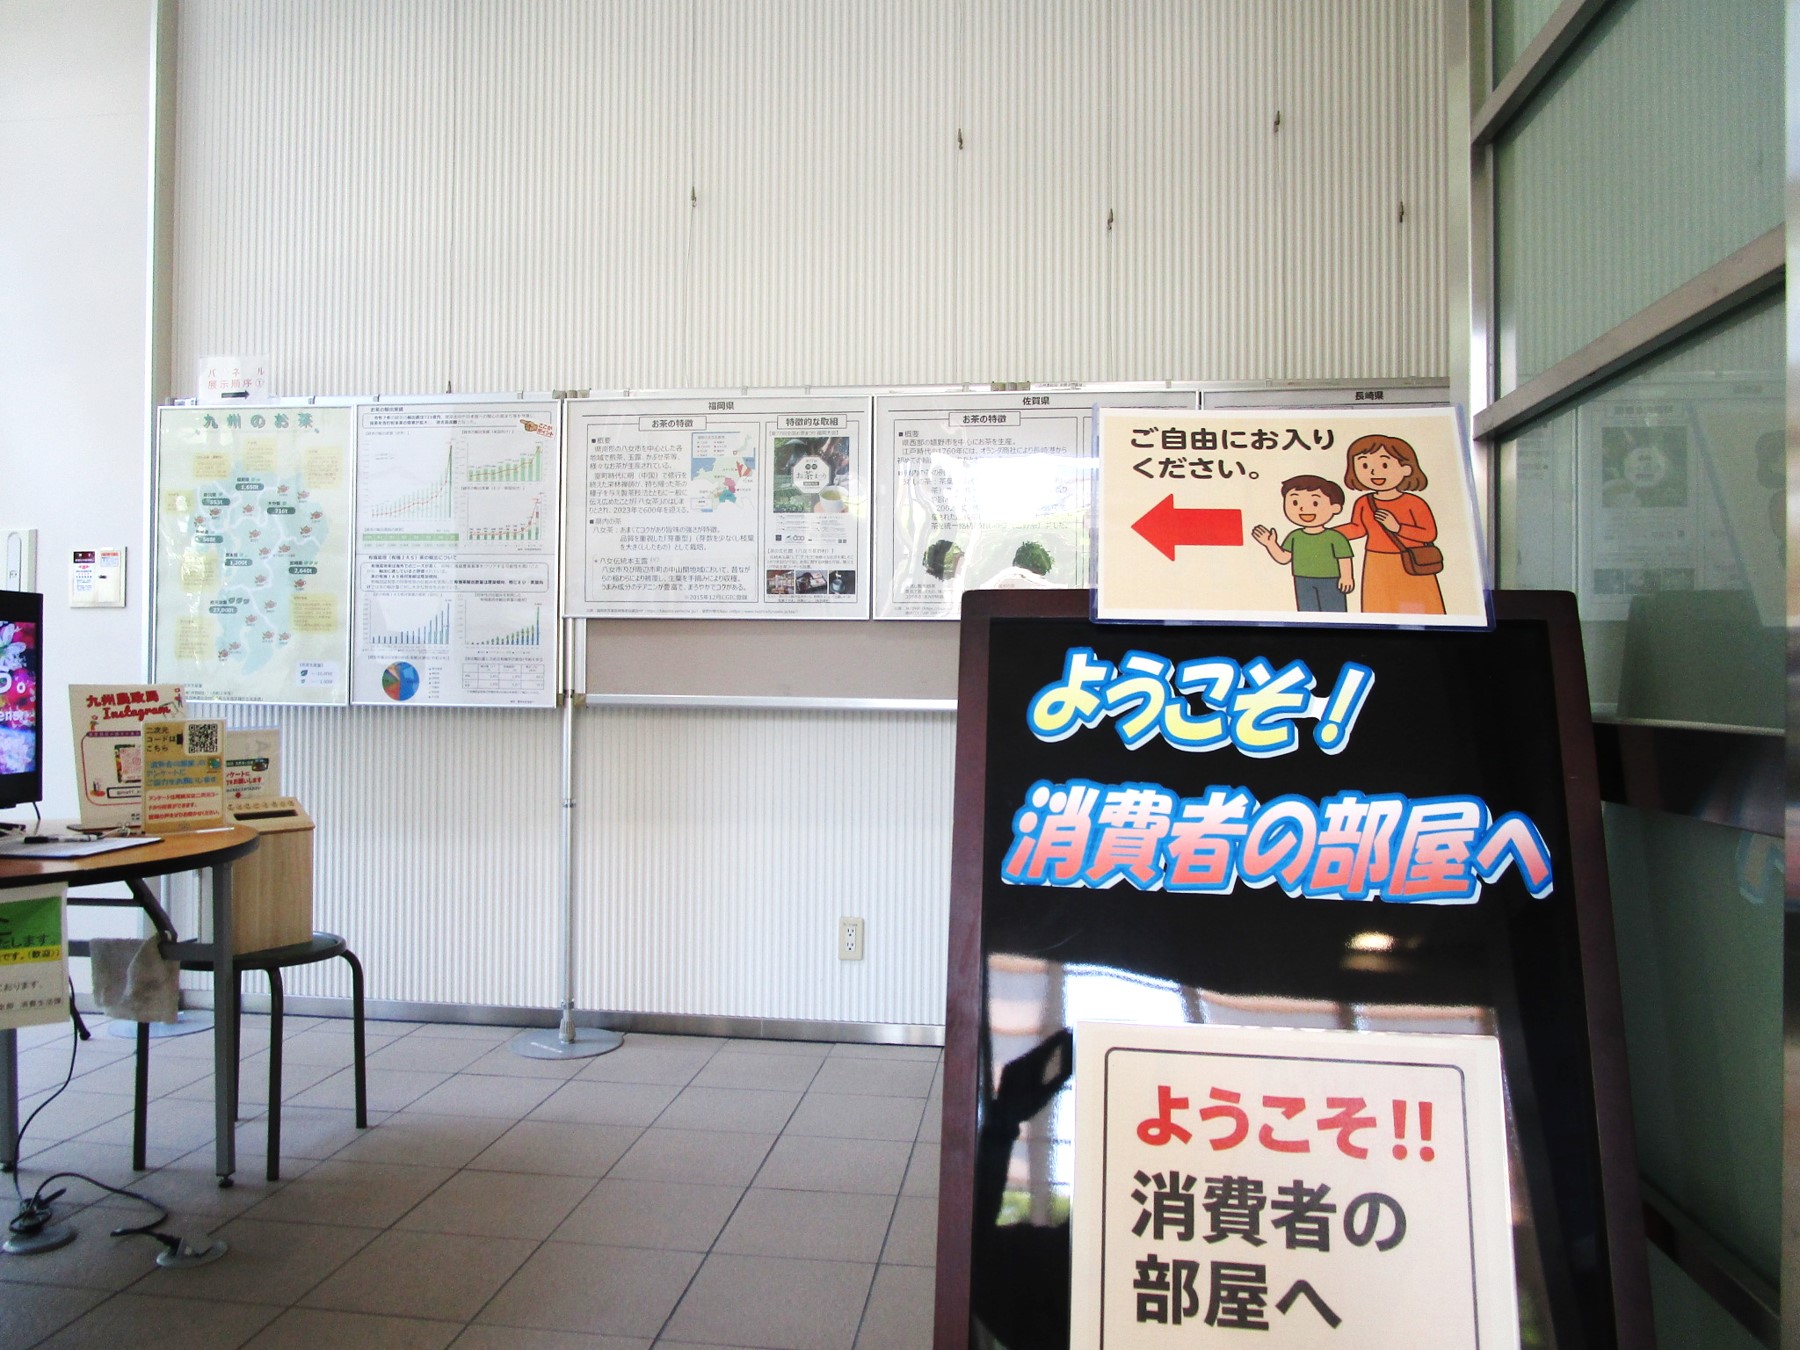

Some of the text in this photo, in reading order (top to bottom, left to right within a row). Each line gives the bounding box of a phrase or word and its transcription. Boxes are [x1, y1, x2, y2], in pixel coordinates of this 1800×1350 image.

[1022, 396, 1050, 406] 佐賀県
[1355, 391, 1384, 401] 長崎県
[708, 401, 735, 411] 福岡県
[203, 413, 313, 429] 九州のお茶
[652, 419, 694, 428] お茶の特徴
[786, 417, 839, 427] 特徴的な取組
[962, 415, 1007, 424] お茶の特徴
[1129, 428, 1336, 451] ご自由にお入り
[1133, 456, 1261, 480] ください。
[86, 690, 159, 708] 九州農政局
[103, 705, 171, 721] Instagram
[145, 726, 169, 734] 二次元
[146, 744, 169, 752] こちら
[1000, 778, 1554, 906] 消費者の部屋へ
[1131, 1168, 1407, 1254] 消費者の
[1132, 1253, 1343, 1332] 部屋へ
